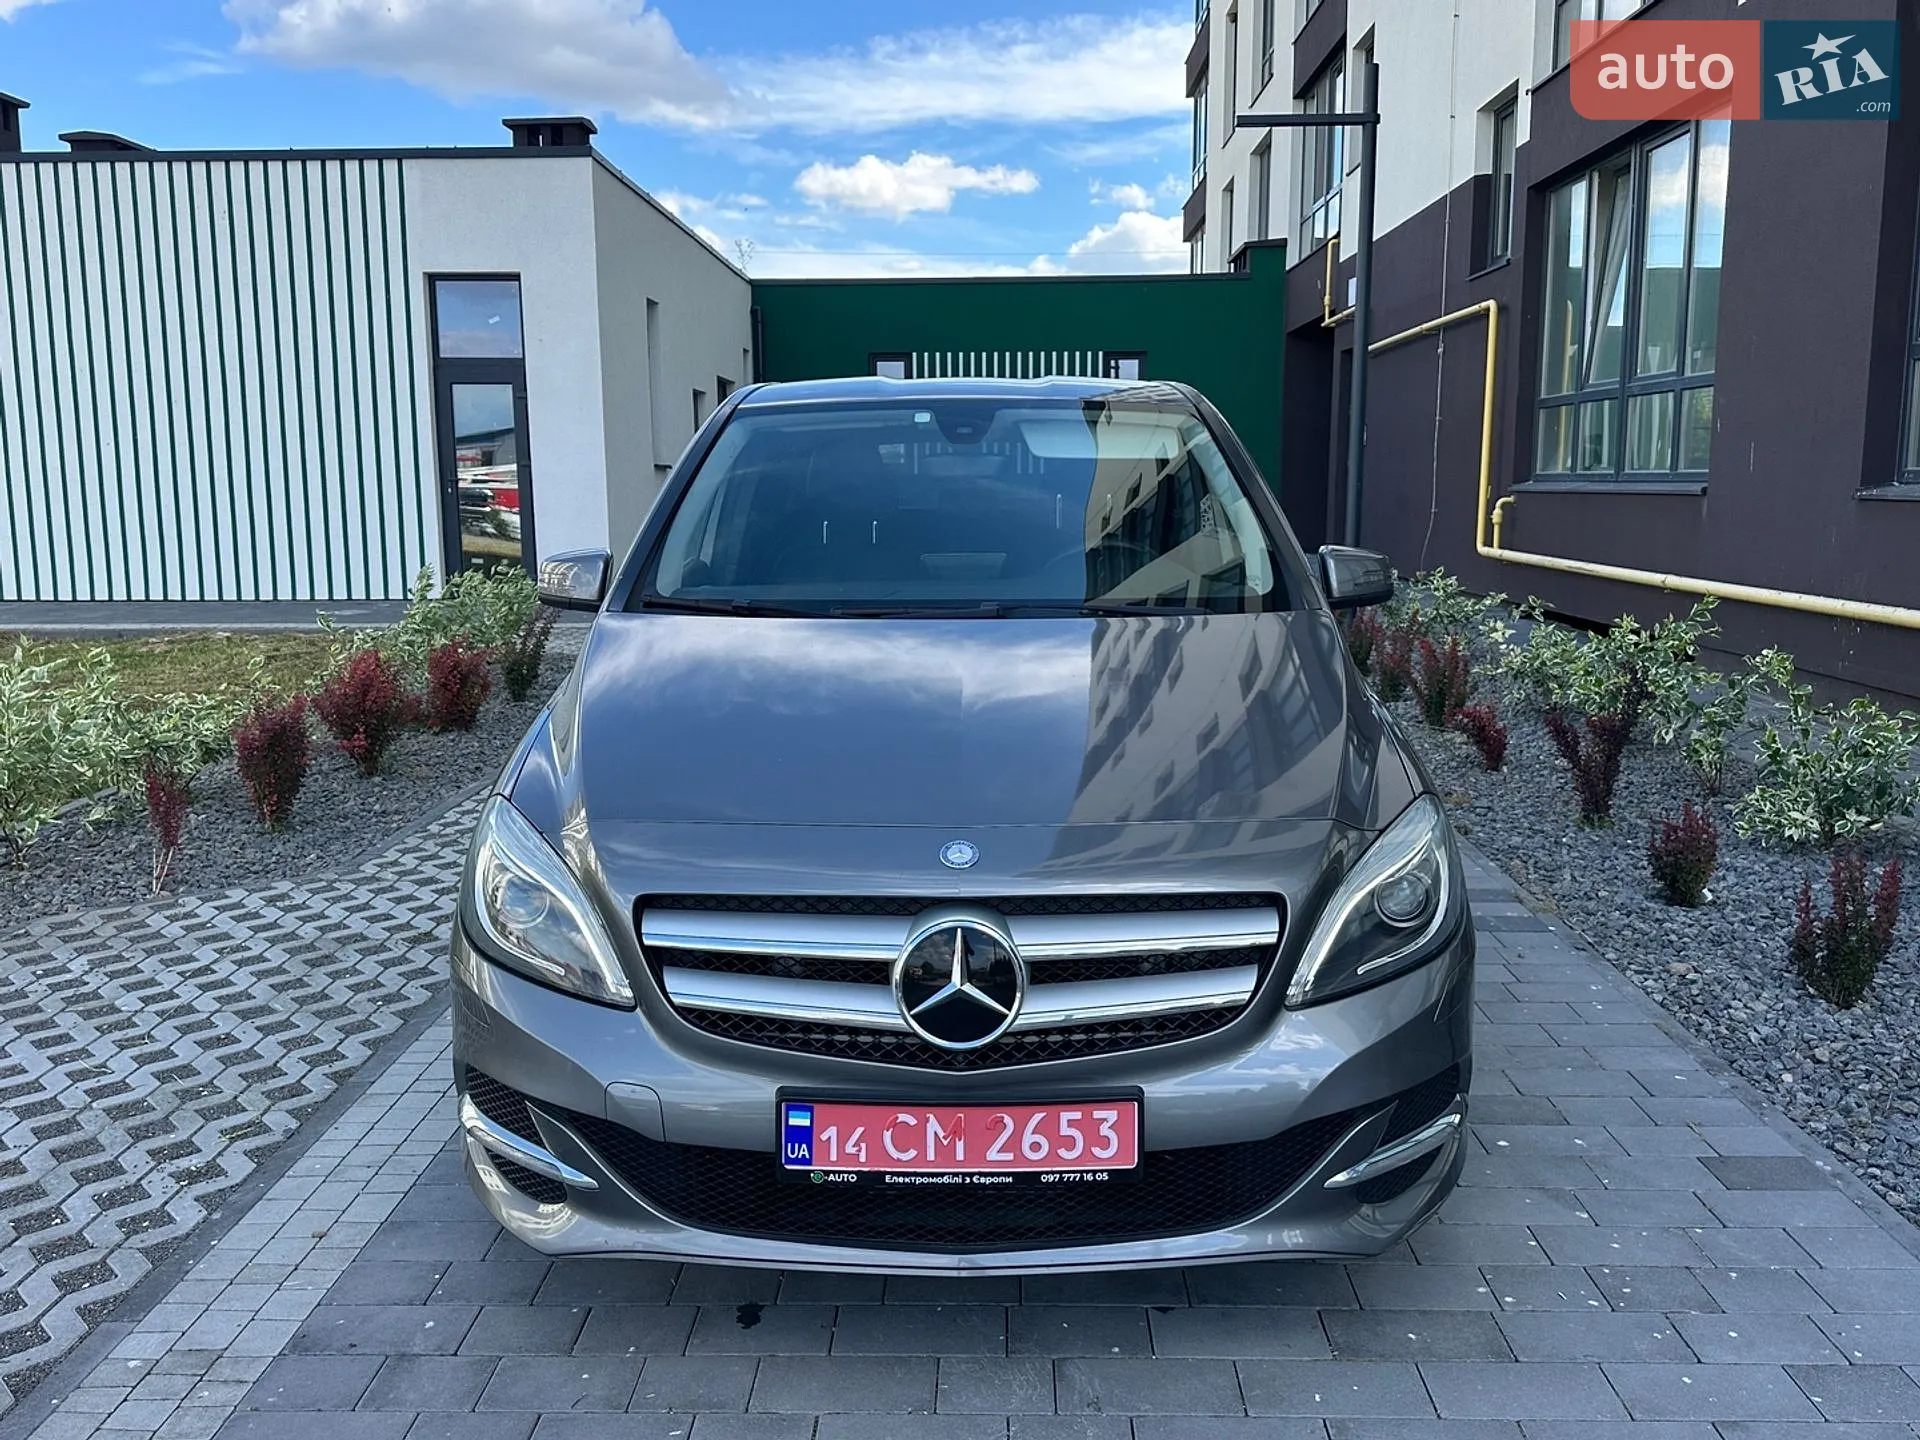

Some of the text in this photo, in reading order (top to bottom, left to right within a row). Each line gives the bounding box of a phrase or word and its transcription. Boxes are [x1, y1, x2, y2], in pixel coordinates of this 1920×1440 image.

[819, 1110, 1119, 1163] 14 CM 2653
[787, 1142, 810, 1160] UA
[885, 1174, 963, 1185] Електромобілі
[972, 1174, 1013, 1185] Європи
[1040, 1171, 1109, 1183] 097 777 16 05
